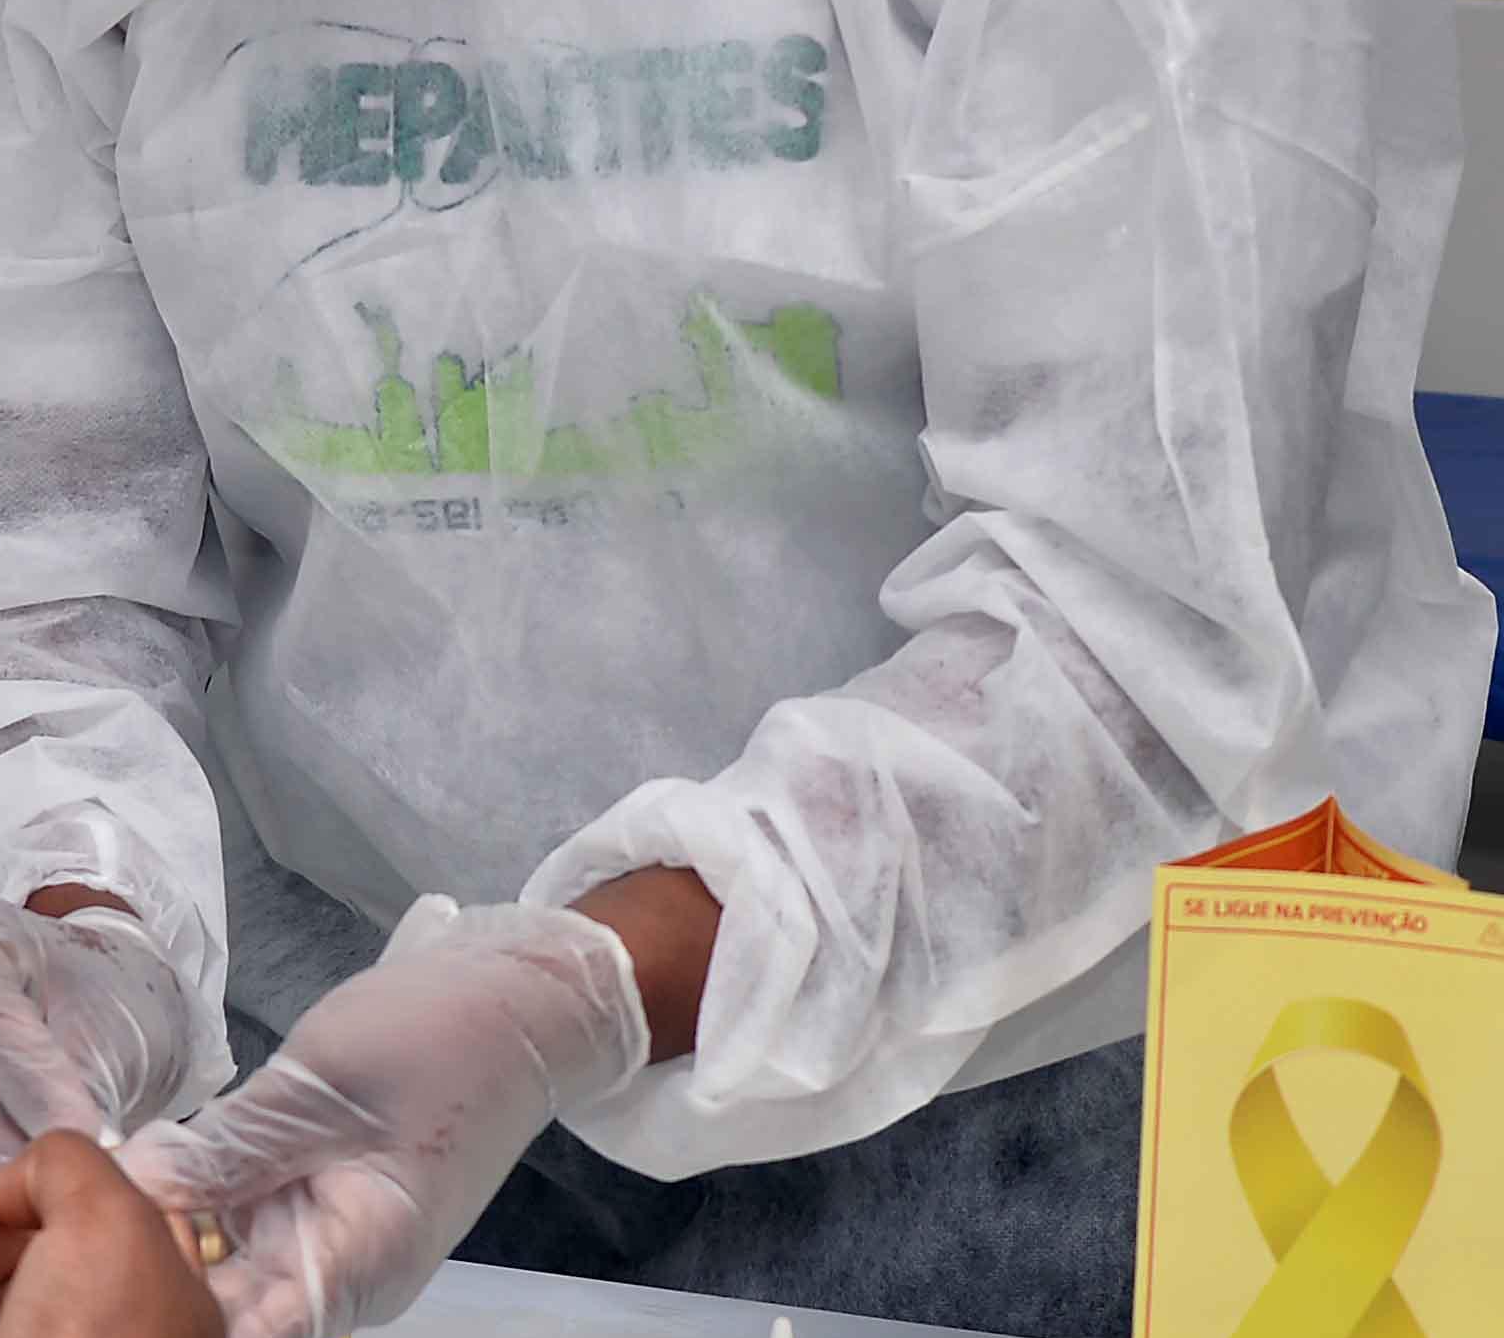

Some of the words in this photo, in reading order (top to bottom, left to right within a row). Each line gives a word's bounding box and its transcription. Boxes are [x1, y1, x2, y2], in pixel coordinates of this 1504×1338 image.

[1183, 898, 1205, 917] SE
[1213, 899, 1269, 920] LIGUE
[1275, 901, 1303, 922] NA
[1308, 904, 1428, 934] PREVENÇÃO
